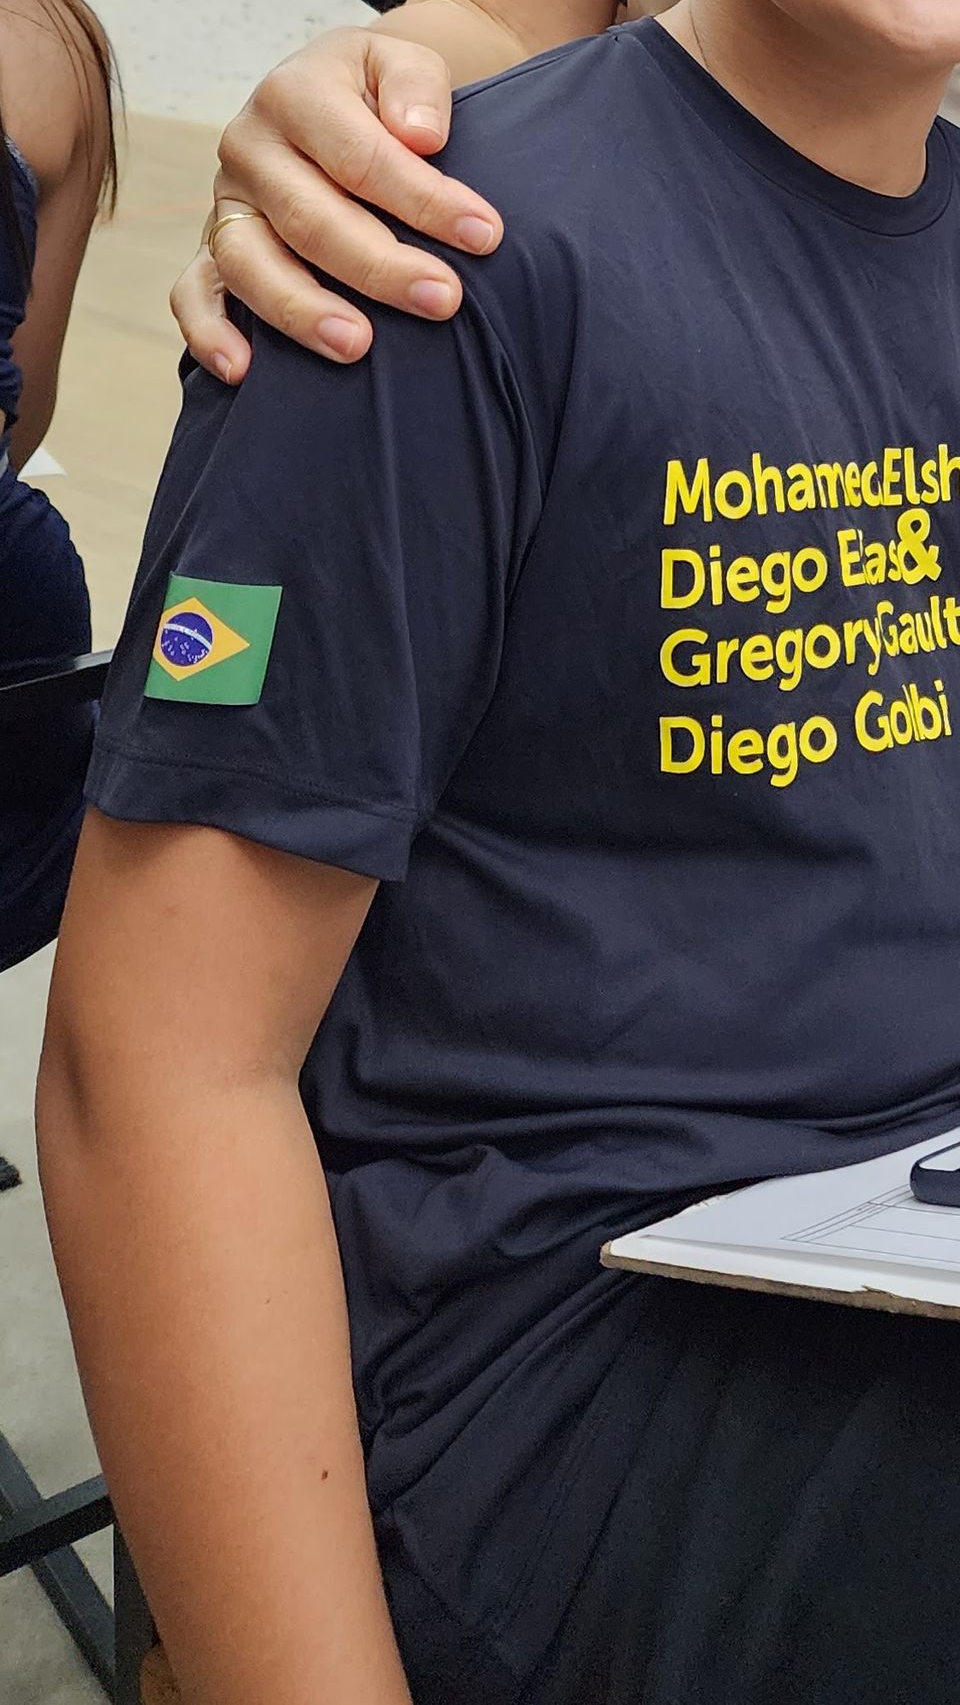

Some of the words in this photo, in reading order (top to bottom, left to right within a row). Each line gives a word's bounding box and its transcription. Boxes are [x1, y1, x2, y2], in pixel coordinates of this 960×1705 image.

[660, 545, 828, 614] Diego
[836, 528, 903, 588] Eas
[896, 507, 942, 586] &
[659, 616, 882, 692] Gregory
[659, 714, 838, 788] Diego
[854, 680, 952, 752] Gobi
